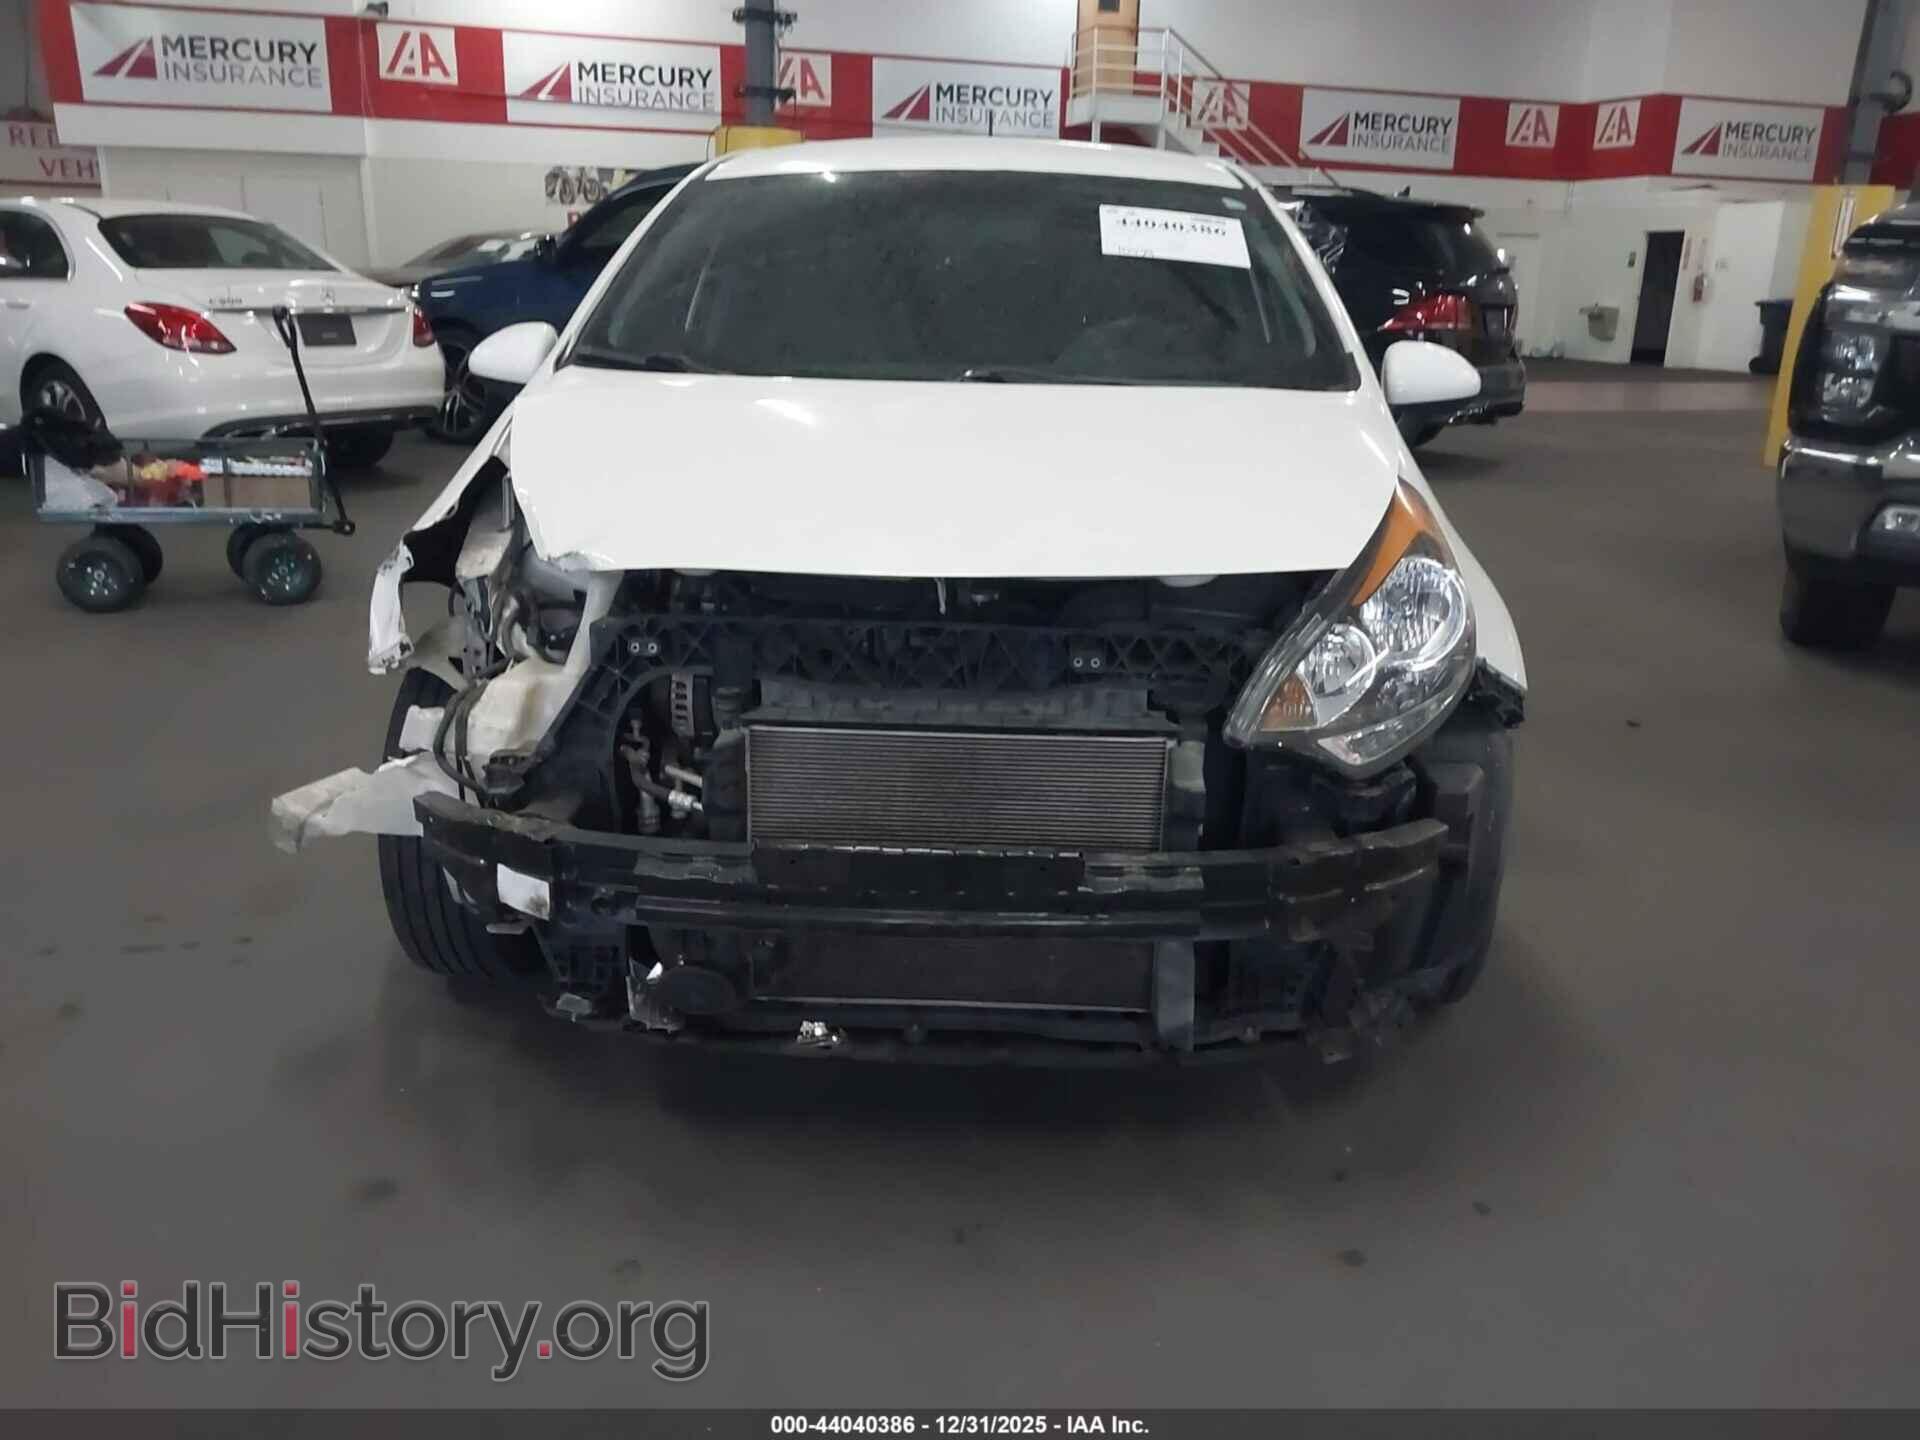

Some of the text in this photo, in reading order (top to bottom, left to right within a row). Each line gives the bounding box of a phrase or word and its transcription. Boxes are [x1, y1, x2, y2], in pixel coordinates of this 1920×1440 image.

[161, 34, 318, 65] MERCURY
[163, 62, 322, 88] INSURANCE
[577, 61, 712, 88] MERCURY
[578, 85, 716, 109] INSURANCE
[936, 83, 1054, 106] MERCURY
[935, 106, 1055, 128] INSURANCE
[1354, 111, 1453, 135] MERCURY
[1351, 133, 1451, 153] INSURANCE
[1725, 121, 1816, 143] MERCURY
[1722, 143, 1814, 161] INSURANCE
